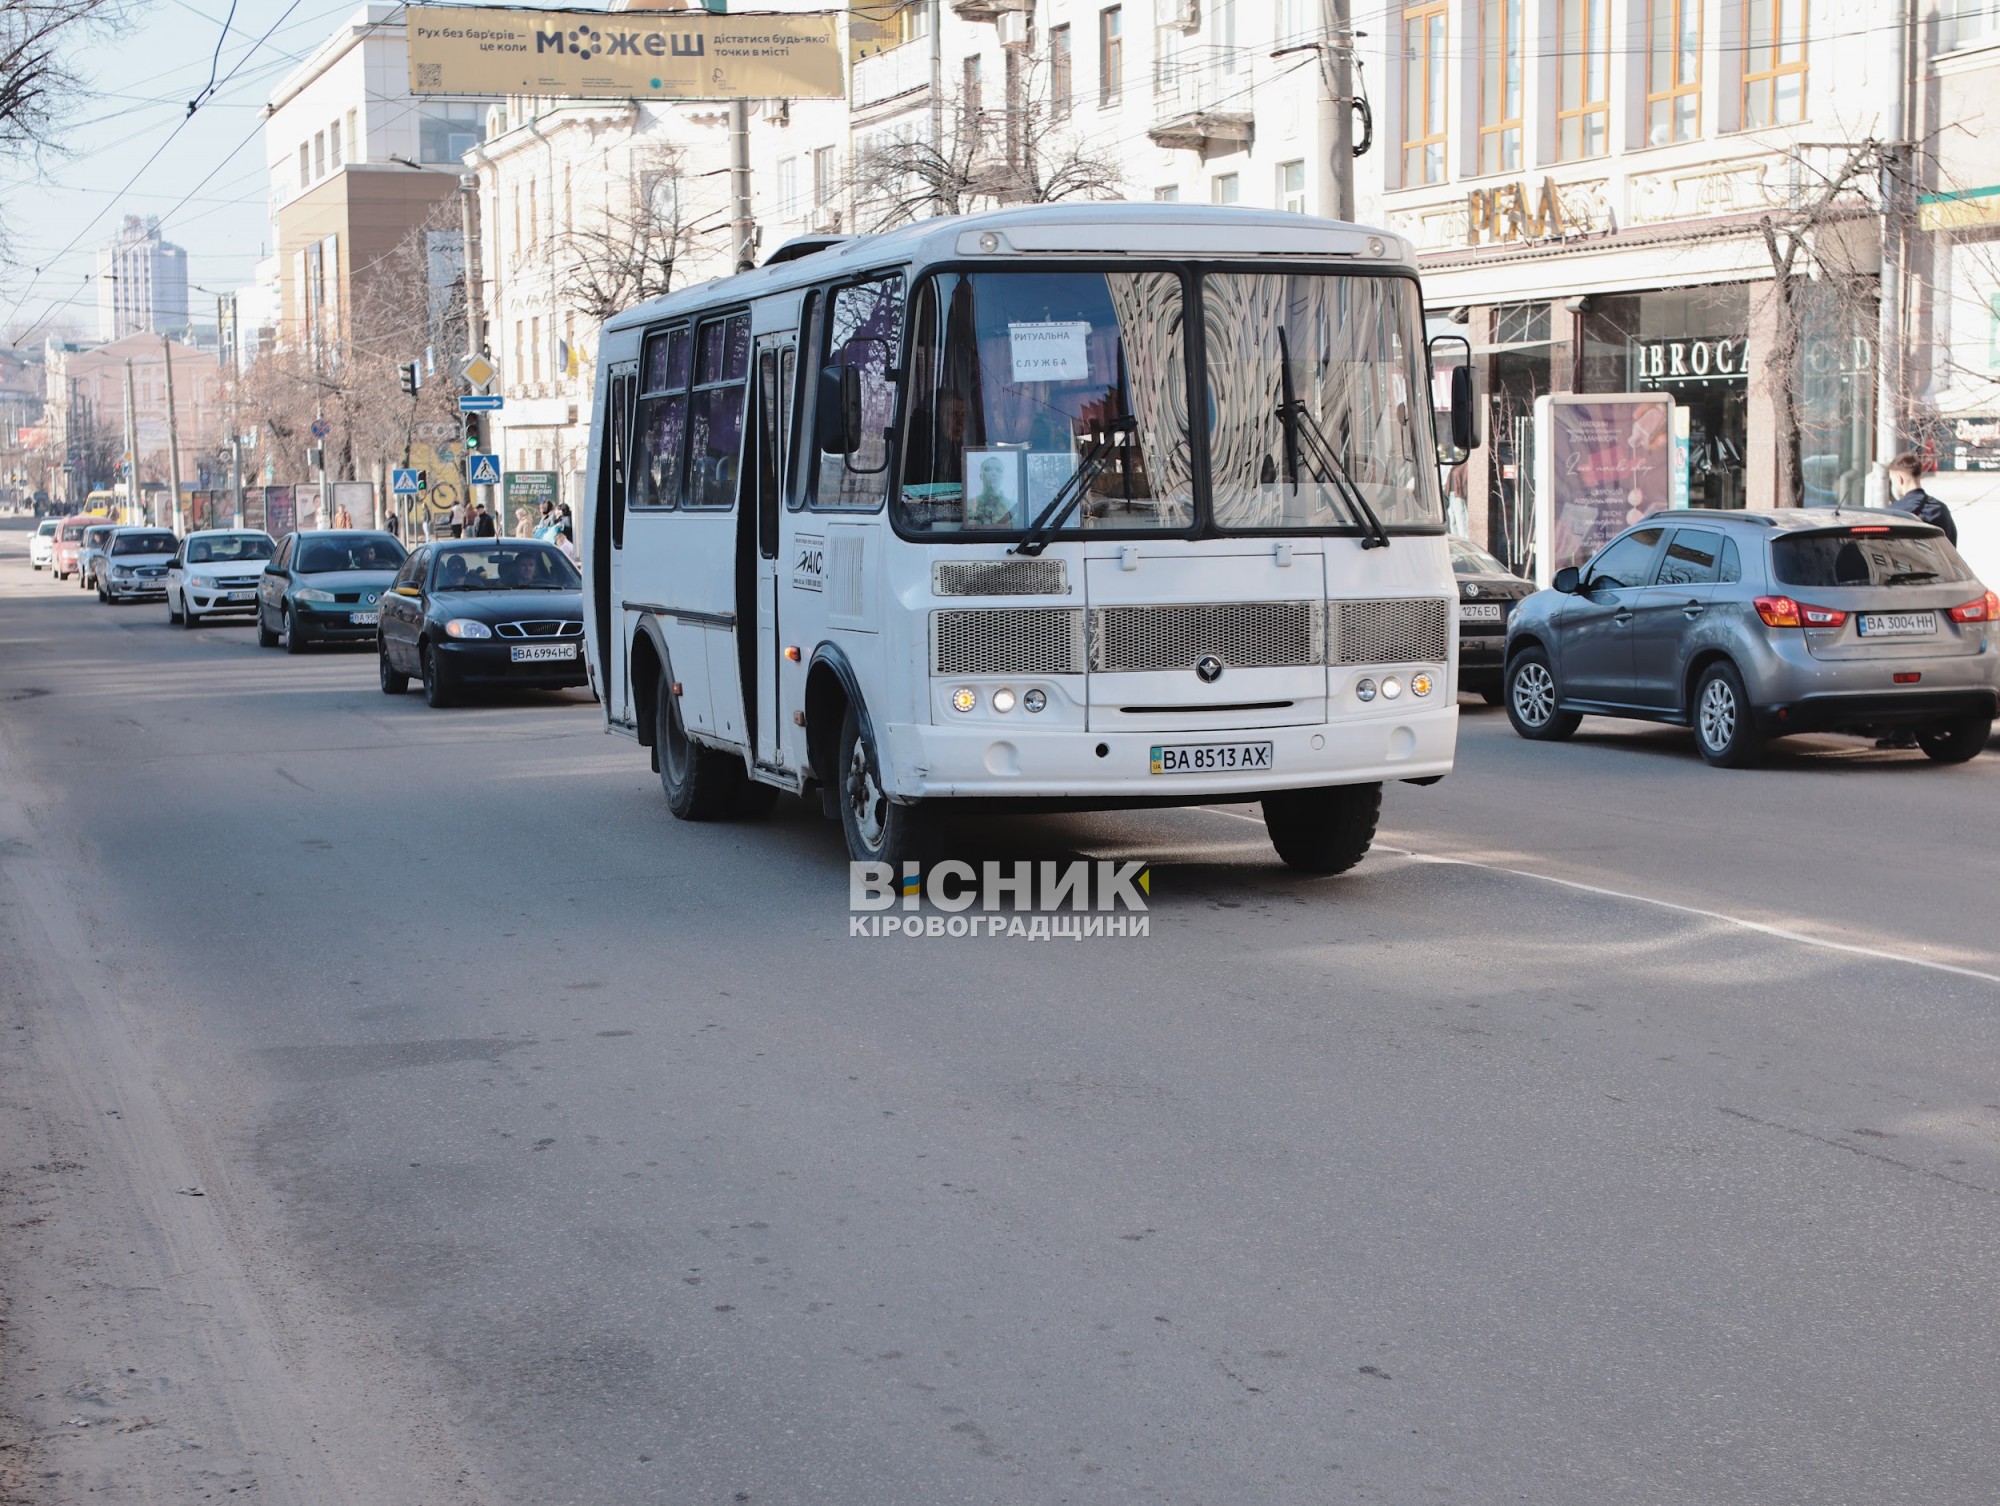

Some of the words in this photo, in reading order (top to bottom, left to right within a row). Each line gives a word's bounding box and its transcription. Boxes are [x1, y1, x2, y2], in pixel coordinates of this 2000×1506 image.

[418, 28, 440, 38] Рух
[442, 28, 463, 38] без
[713, 33, 770, 44] дістатися
[772, 33, 830, 45] будь-якої
[480, 43, 495, 52] це
[497, 44, 527, 52] коли
[714, 49, 749, 57] точки
[762, 46, 789, 57] місті
[1014, 332, 1070, 341] РИТУАЛЬНА
[1016, 358, 1068, 368] СЛУЖБА
[1462, 606, 1483, 617] 1276
[1484, 606, 1498, 617] EO
[1867, 617, 1885, 630] BA
[1888, 616, 1915, 629] 3004
[1917, 615, 1934, 628] HH
[517, 649, 532, 659] BA
[534, 648, 558, 659] 6994
[558, 647, 573, 658] HC
[1163, 750, 1190, 770] BA
[1194, 748, 1236, 768] 8513
[1241, 746, 1267, 767] AX
